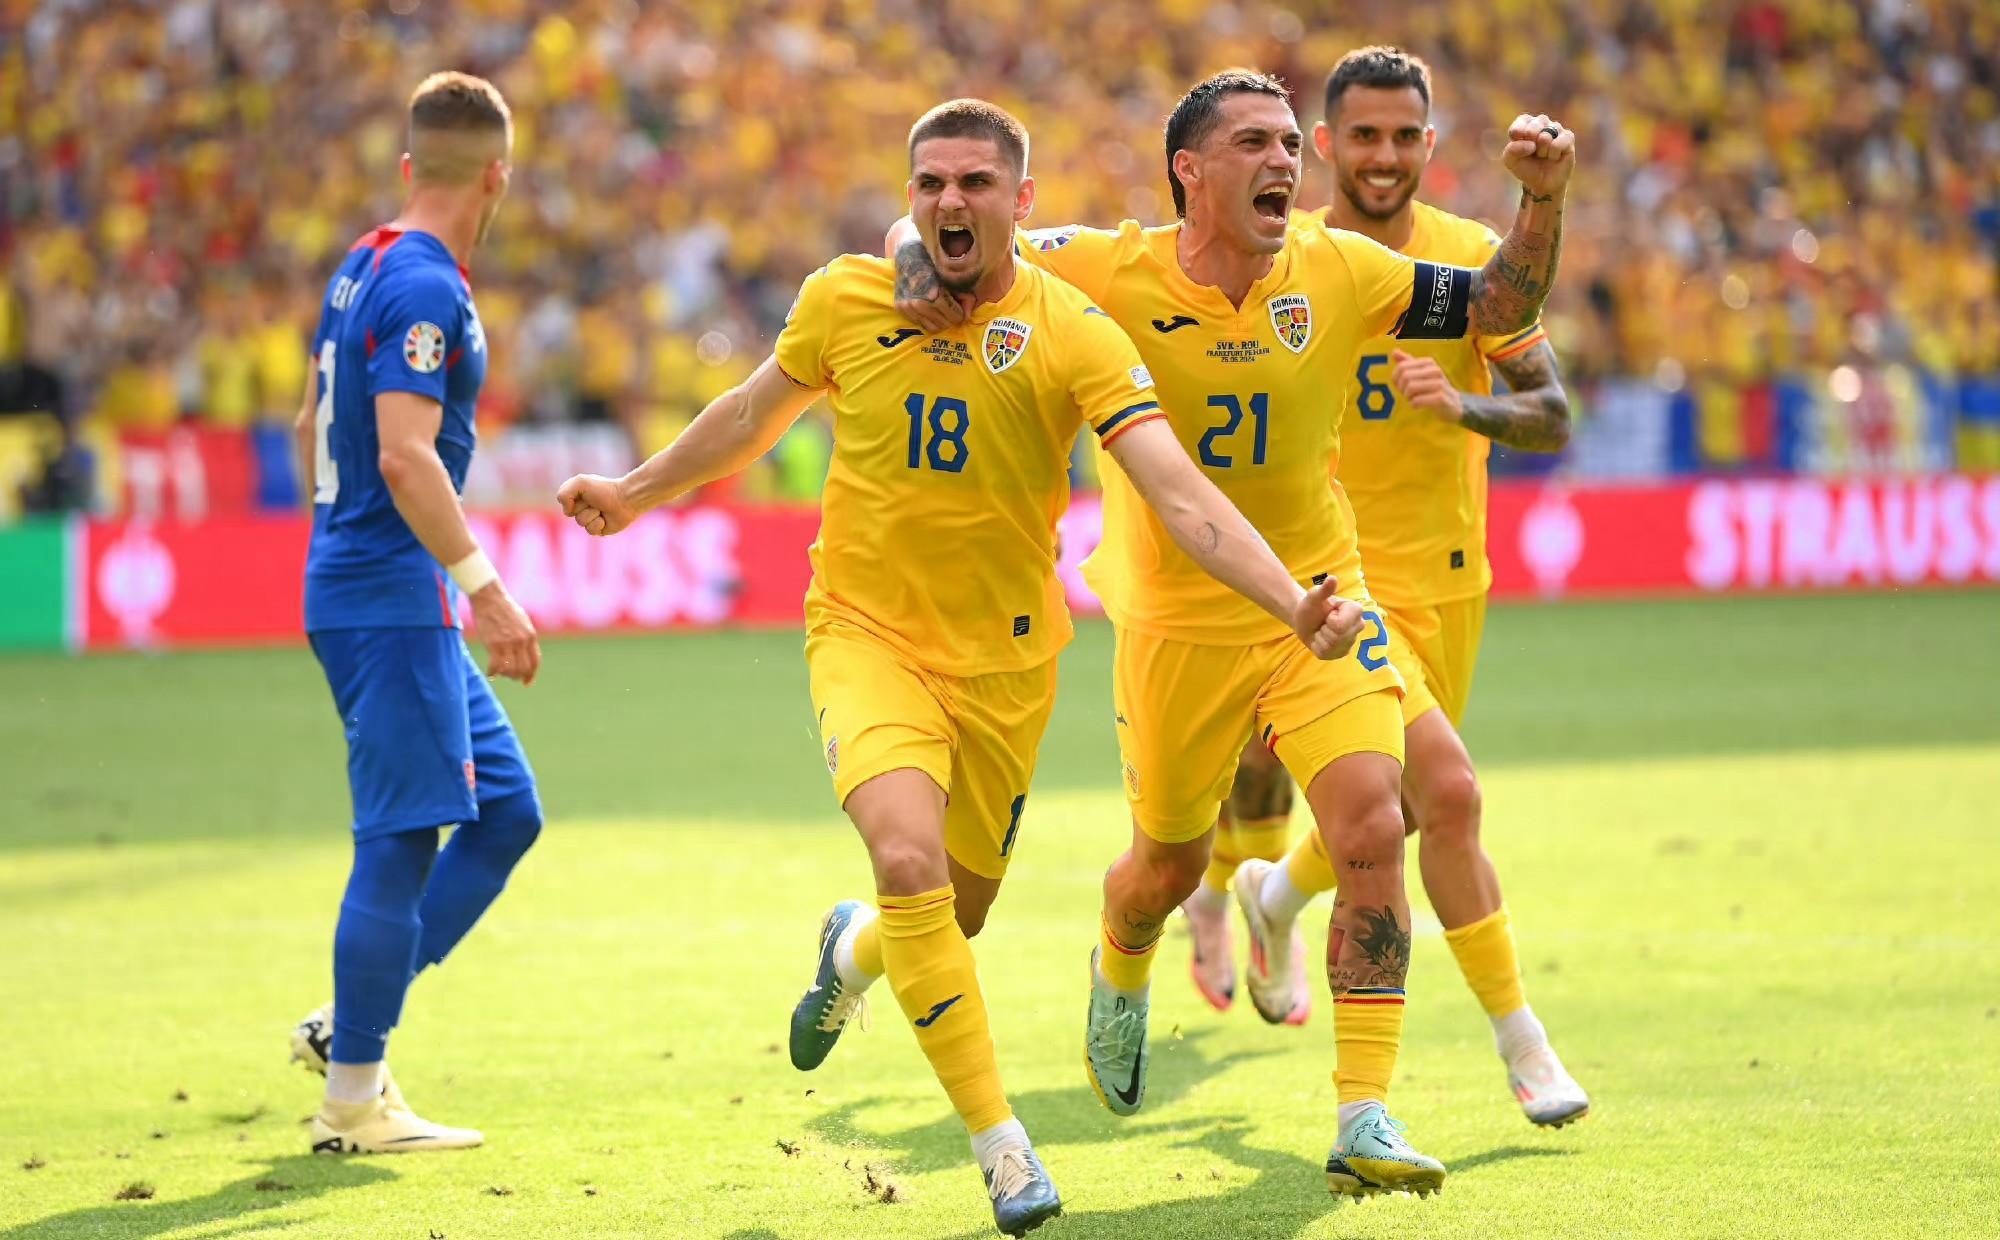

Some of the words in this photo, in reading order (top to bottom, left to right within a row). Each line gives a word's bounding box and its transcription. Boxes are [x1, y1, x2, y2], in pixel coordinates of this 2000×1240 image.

[1433, 266, 1451, 313] RESPEC
[932, 338, 949, 349] SVK
[1206, 349, 1244, 357] FRANKFURT
[1216, 341, 1234, 350] SVK
[1241, 340, 1259, 350] ROU
[1356, 354, 1395, 420] 6
[904, 392, 970, 473] 18
[1197, 392, 1269, 468] 21
[459, 506, 742, 630] AUSS
[1356, 610, 1389, 673] 2
